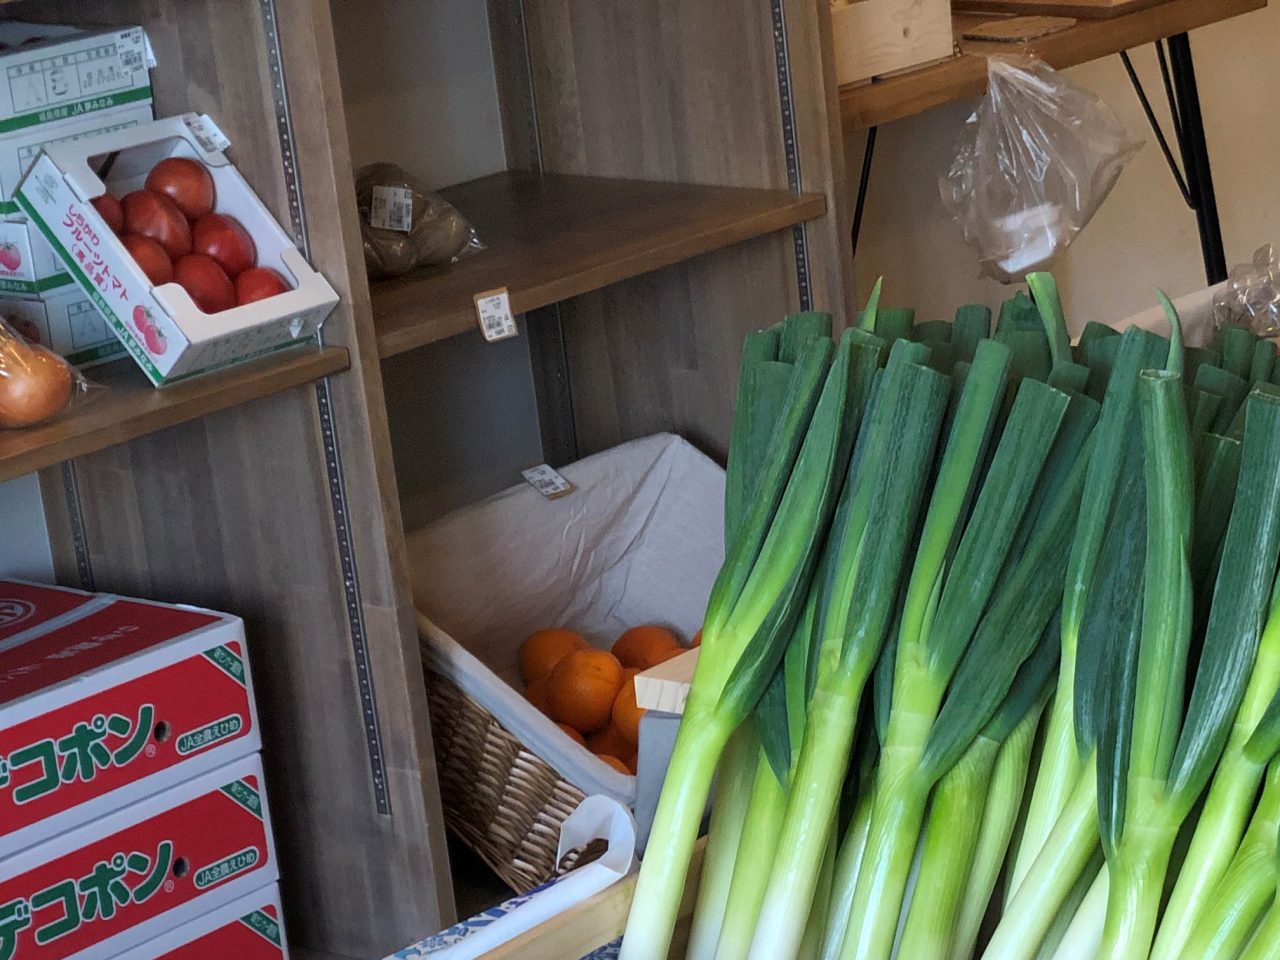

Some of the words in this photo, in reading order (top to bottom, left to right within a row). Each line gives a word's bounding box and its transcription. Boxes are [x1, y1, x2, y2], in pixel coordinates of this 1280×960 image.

[63, 213, 129, 301] フルーツトマト
[68, 204, 100, 247] しらかわ
[0, 703, 154, 804] コポン
